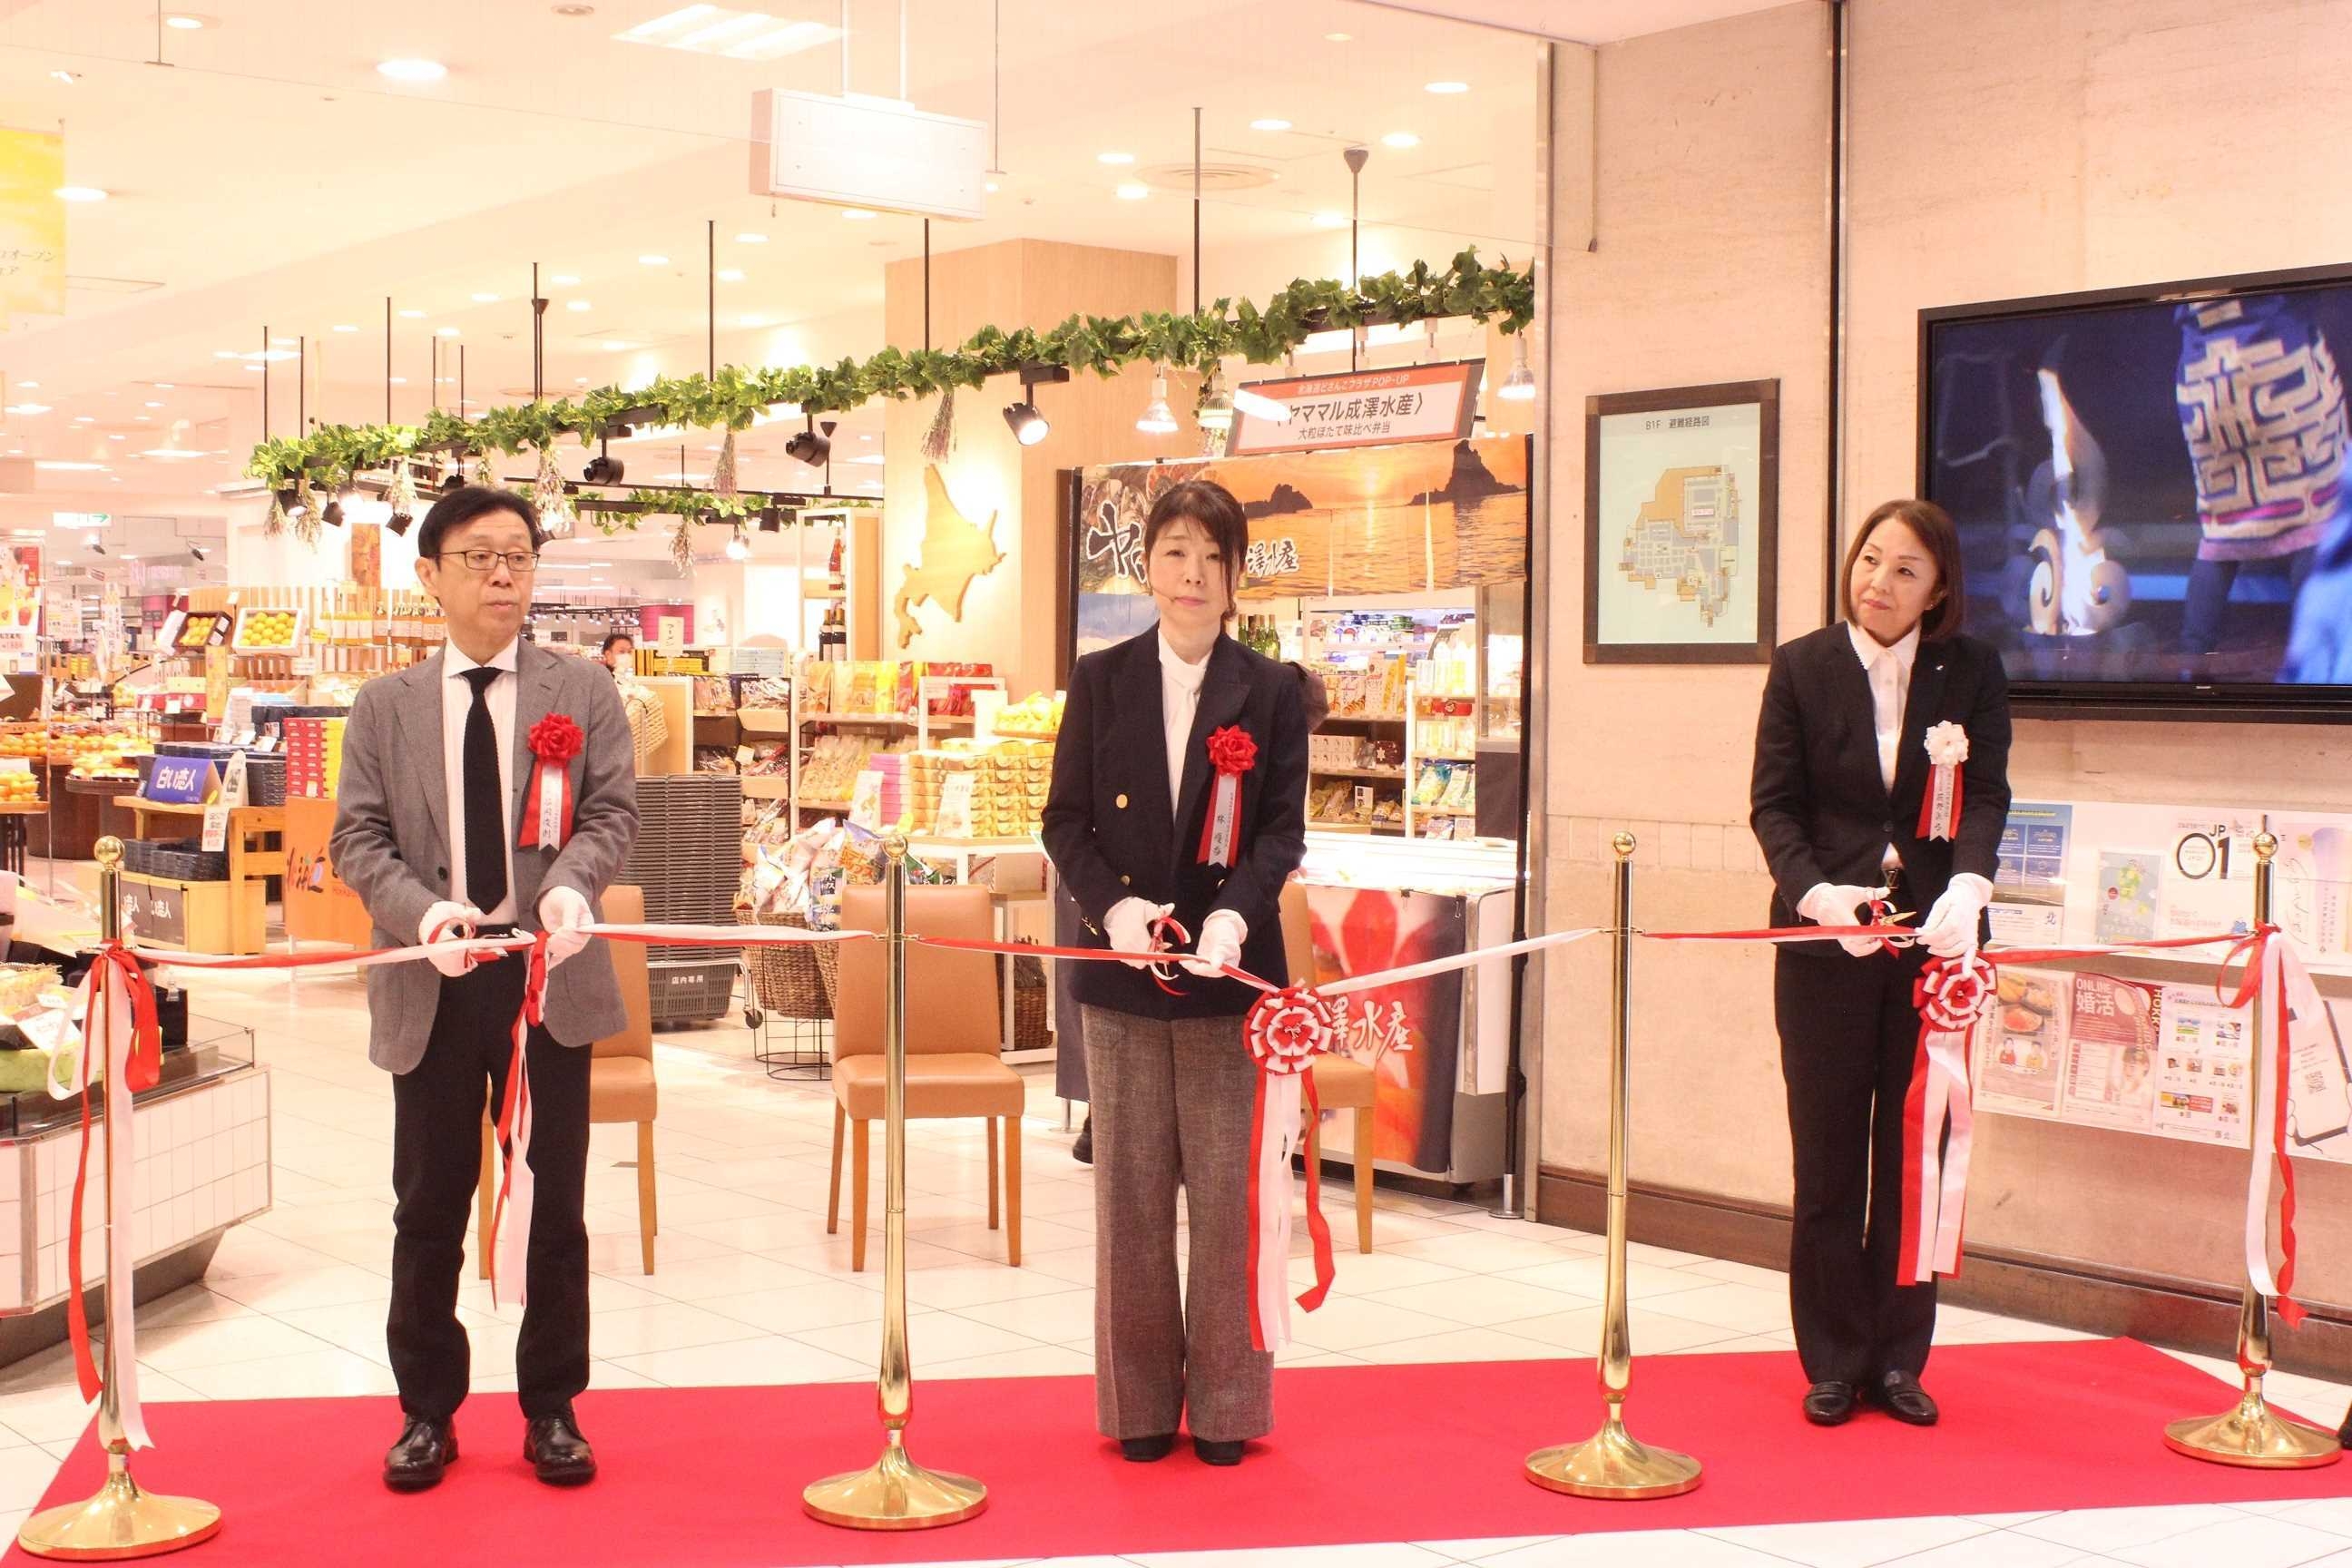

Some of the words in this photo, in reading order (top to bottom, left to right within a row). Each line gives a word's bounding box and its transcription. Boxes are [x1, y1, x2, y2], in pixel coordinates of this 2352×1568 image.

[1298, 421, 1391, 441] 大粒ほたて味比べ弁当
[1645, 419, 1661, 430] B1F
[155, 766, 197, 791] 白い恋人
[2209, 824, 2227, 837] JP
[671, 975, 704, 985] 店内専用
[2076, 978, 2112, 994] ONLINE
[2075, 992, 2114, 1016] 婚活
